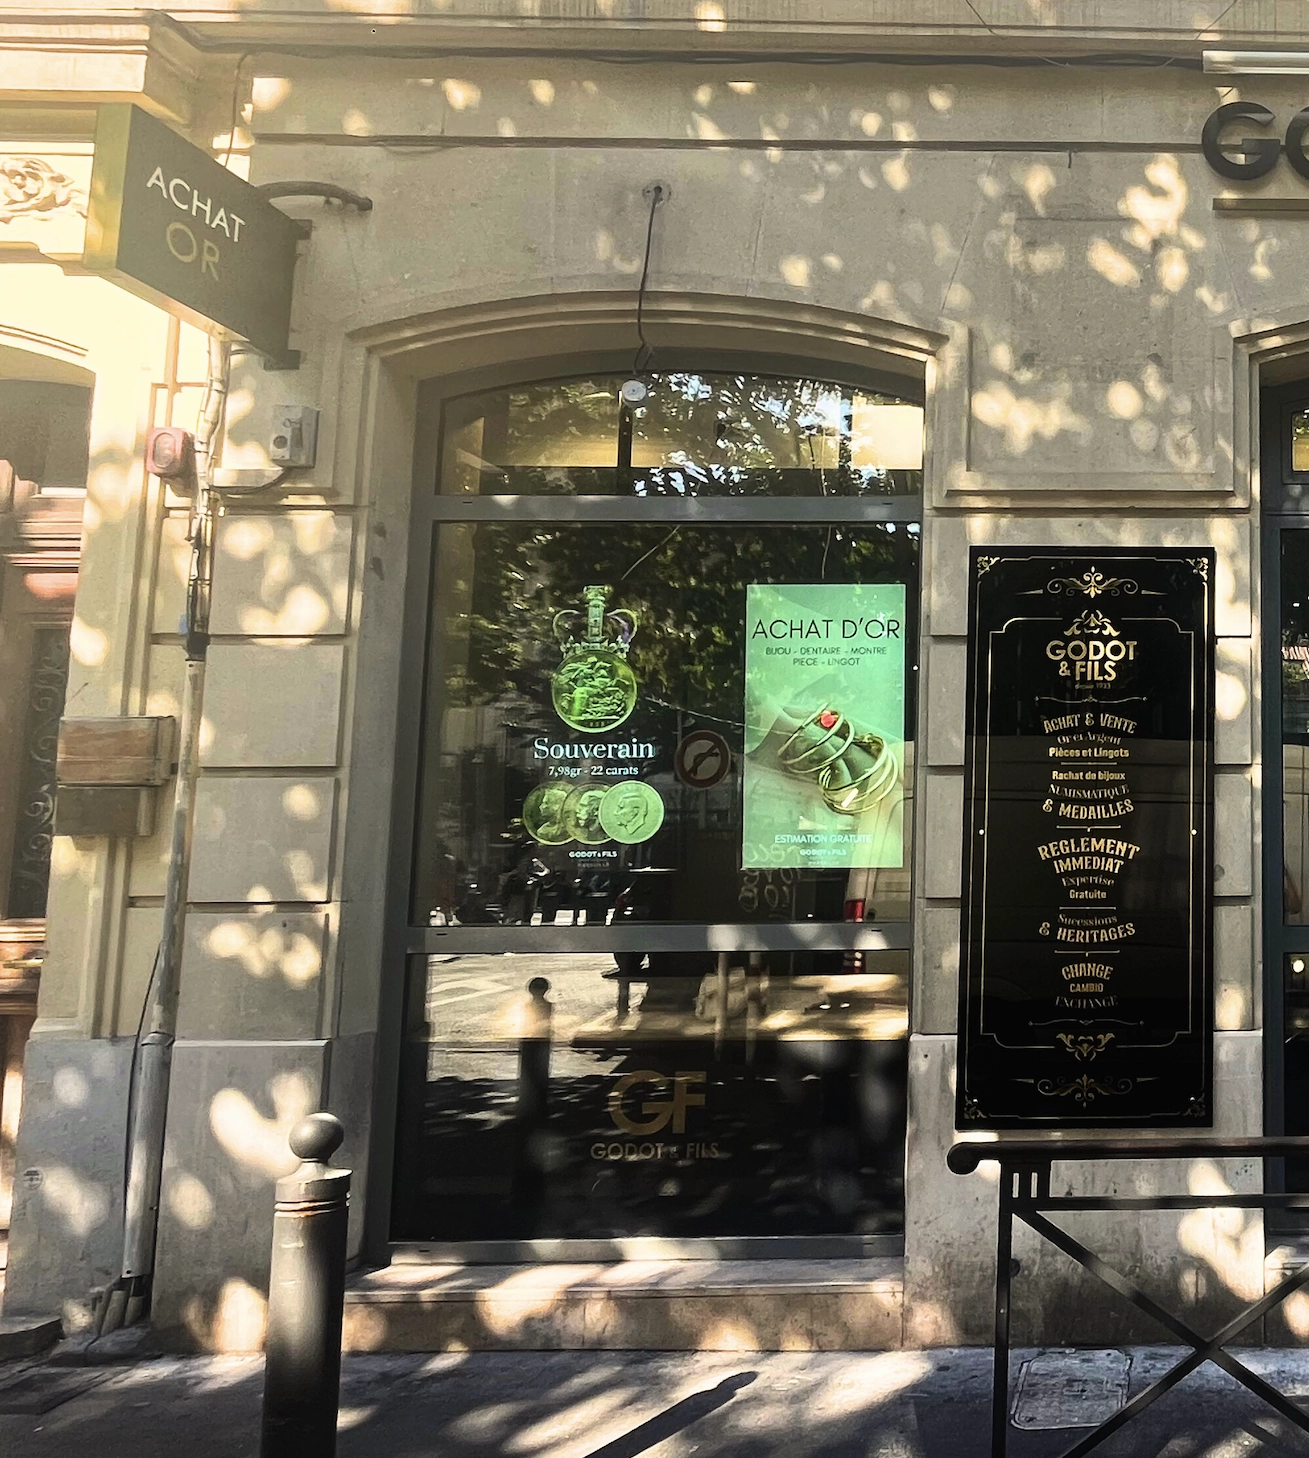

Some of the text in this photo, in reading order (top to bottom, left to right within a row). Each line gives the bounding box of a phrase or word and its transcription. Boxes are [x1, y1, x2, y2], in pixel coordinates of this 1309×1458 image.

[146, 166, 246, 243] ACHAT
[166, 221, 220, 281] OR
[751, 617, 900, 639] ACHAT D'OR
[800, 646, 841, 655] DENTAIRE
[850, 646, 887, 655] MONTRE
[1045, 639, 1138, 661] GODOT
[828, 657, 860, 666] LINGOT
[1058, 660, 1117, 681] & FILS
[1043, 712, 1138, 734] ACHAT & VENTE
[534, 737, 655, 759] Souverain
[1048, 747, 1130, 760] Pièces et Lingots
[548, 765, 582, 778] 7,98gr
[590, 765, 604, 775] 22
[605, 765, 639, 775] carats
[1051, 770, 1126, 782] Rachat de bijoux
[1047, 783, 1131, 800] NUMISMATIQUE
[1042, 798, 1135, 820] & MEDAILLES
[774, 834, 873, 844] ESTIMATION GRATUITE
[1037, 837, 1141, 861] REGLEMENT
[1053, 855, 1125, 874] IMMEDIAT
[1061, 874, 1115, 887] Expertise
[1069, 889, 1107, 899] Gratuite
[1039, 921, 1136, 944] & HERITAGES
[1061, 962, 1114, 981] CHANGE
[609, 1070, 707, 1136] GF
[590, 1142, 665, 1161] GODOT
[685, 1142, 719, 1159] FILS
